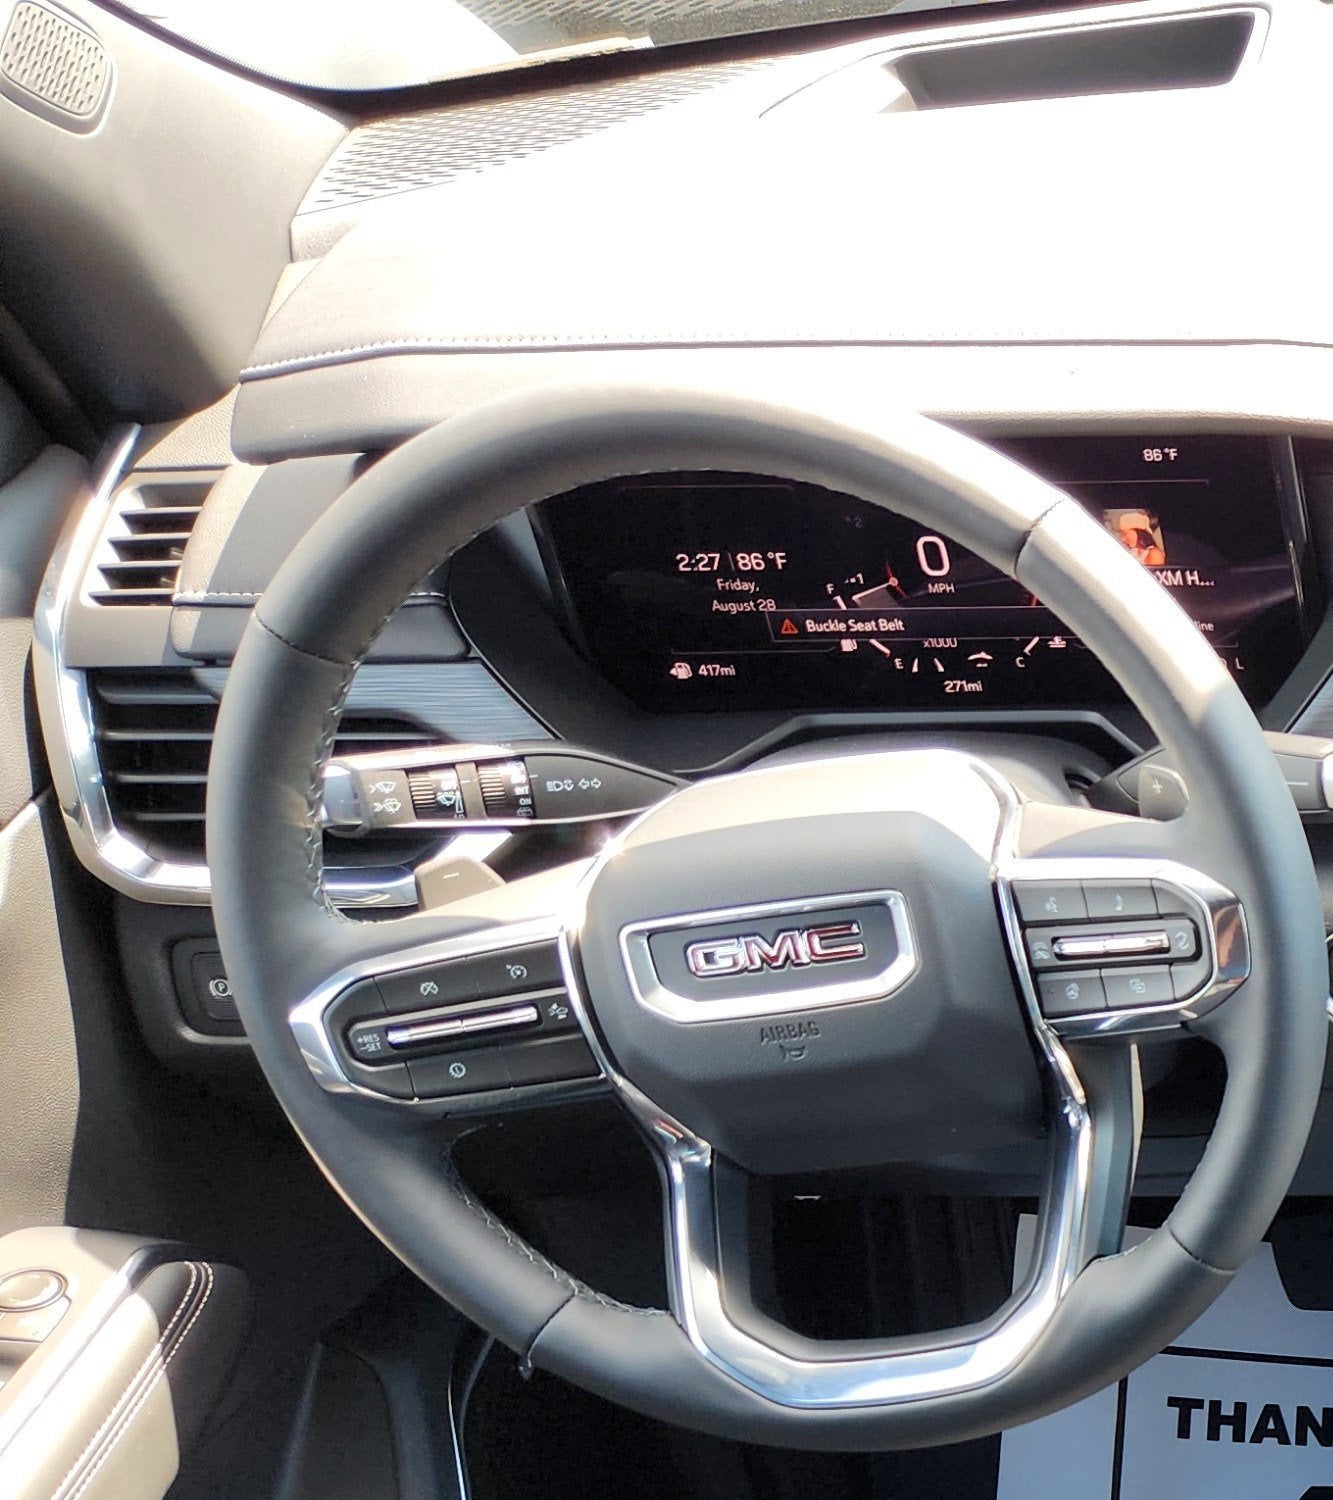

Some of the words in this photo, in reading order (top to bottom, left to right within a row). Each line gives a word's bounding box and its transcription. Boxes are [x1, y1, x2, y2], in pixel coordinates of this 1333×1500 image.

[675, 553, 720, 571] 2:27
[916, 535, 950, 577] 0
[928, 583, 955, 594] MPH
[711, 600, 756, 614] August
[757, 599, 777, 611] 28
[805, 619, 847, 632] Buckle
[848, 619, 878, 632] Seat
[878, 618, 905, 631] Belt
[686, 919, 867, 978] GMC
[760, 1021, 820, 1044] AIRBAG
